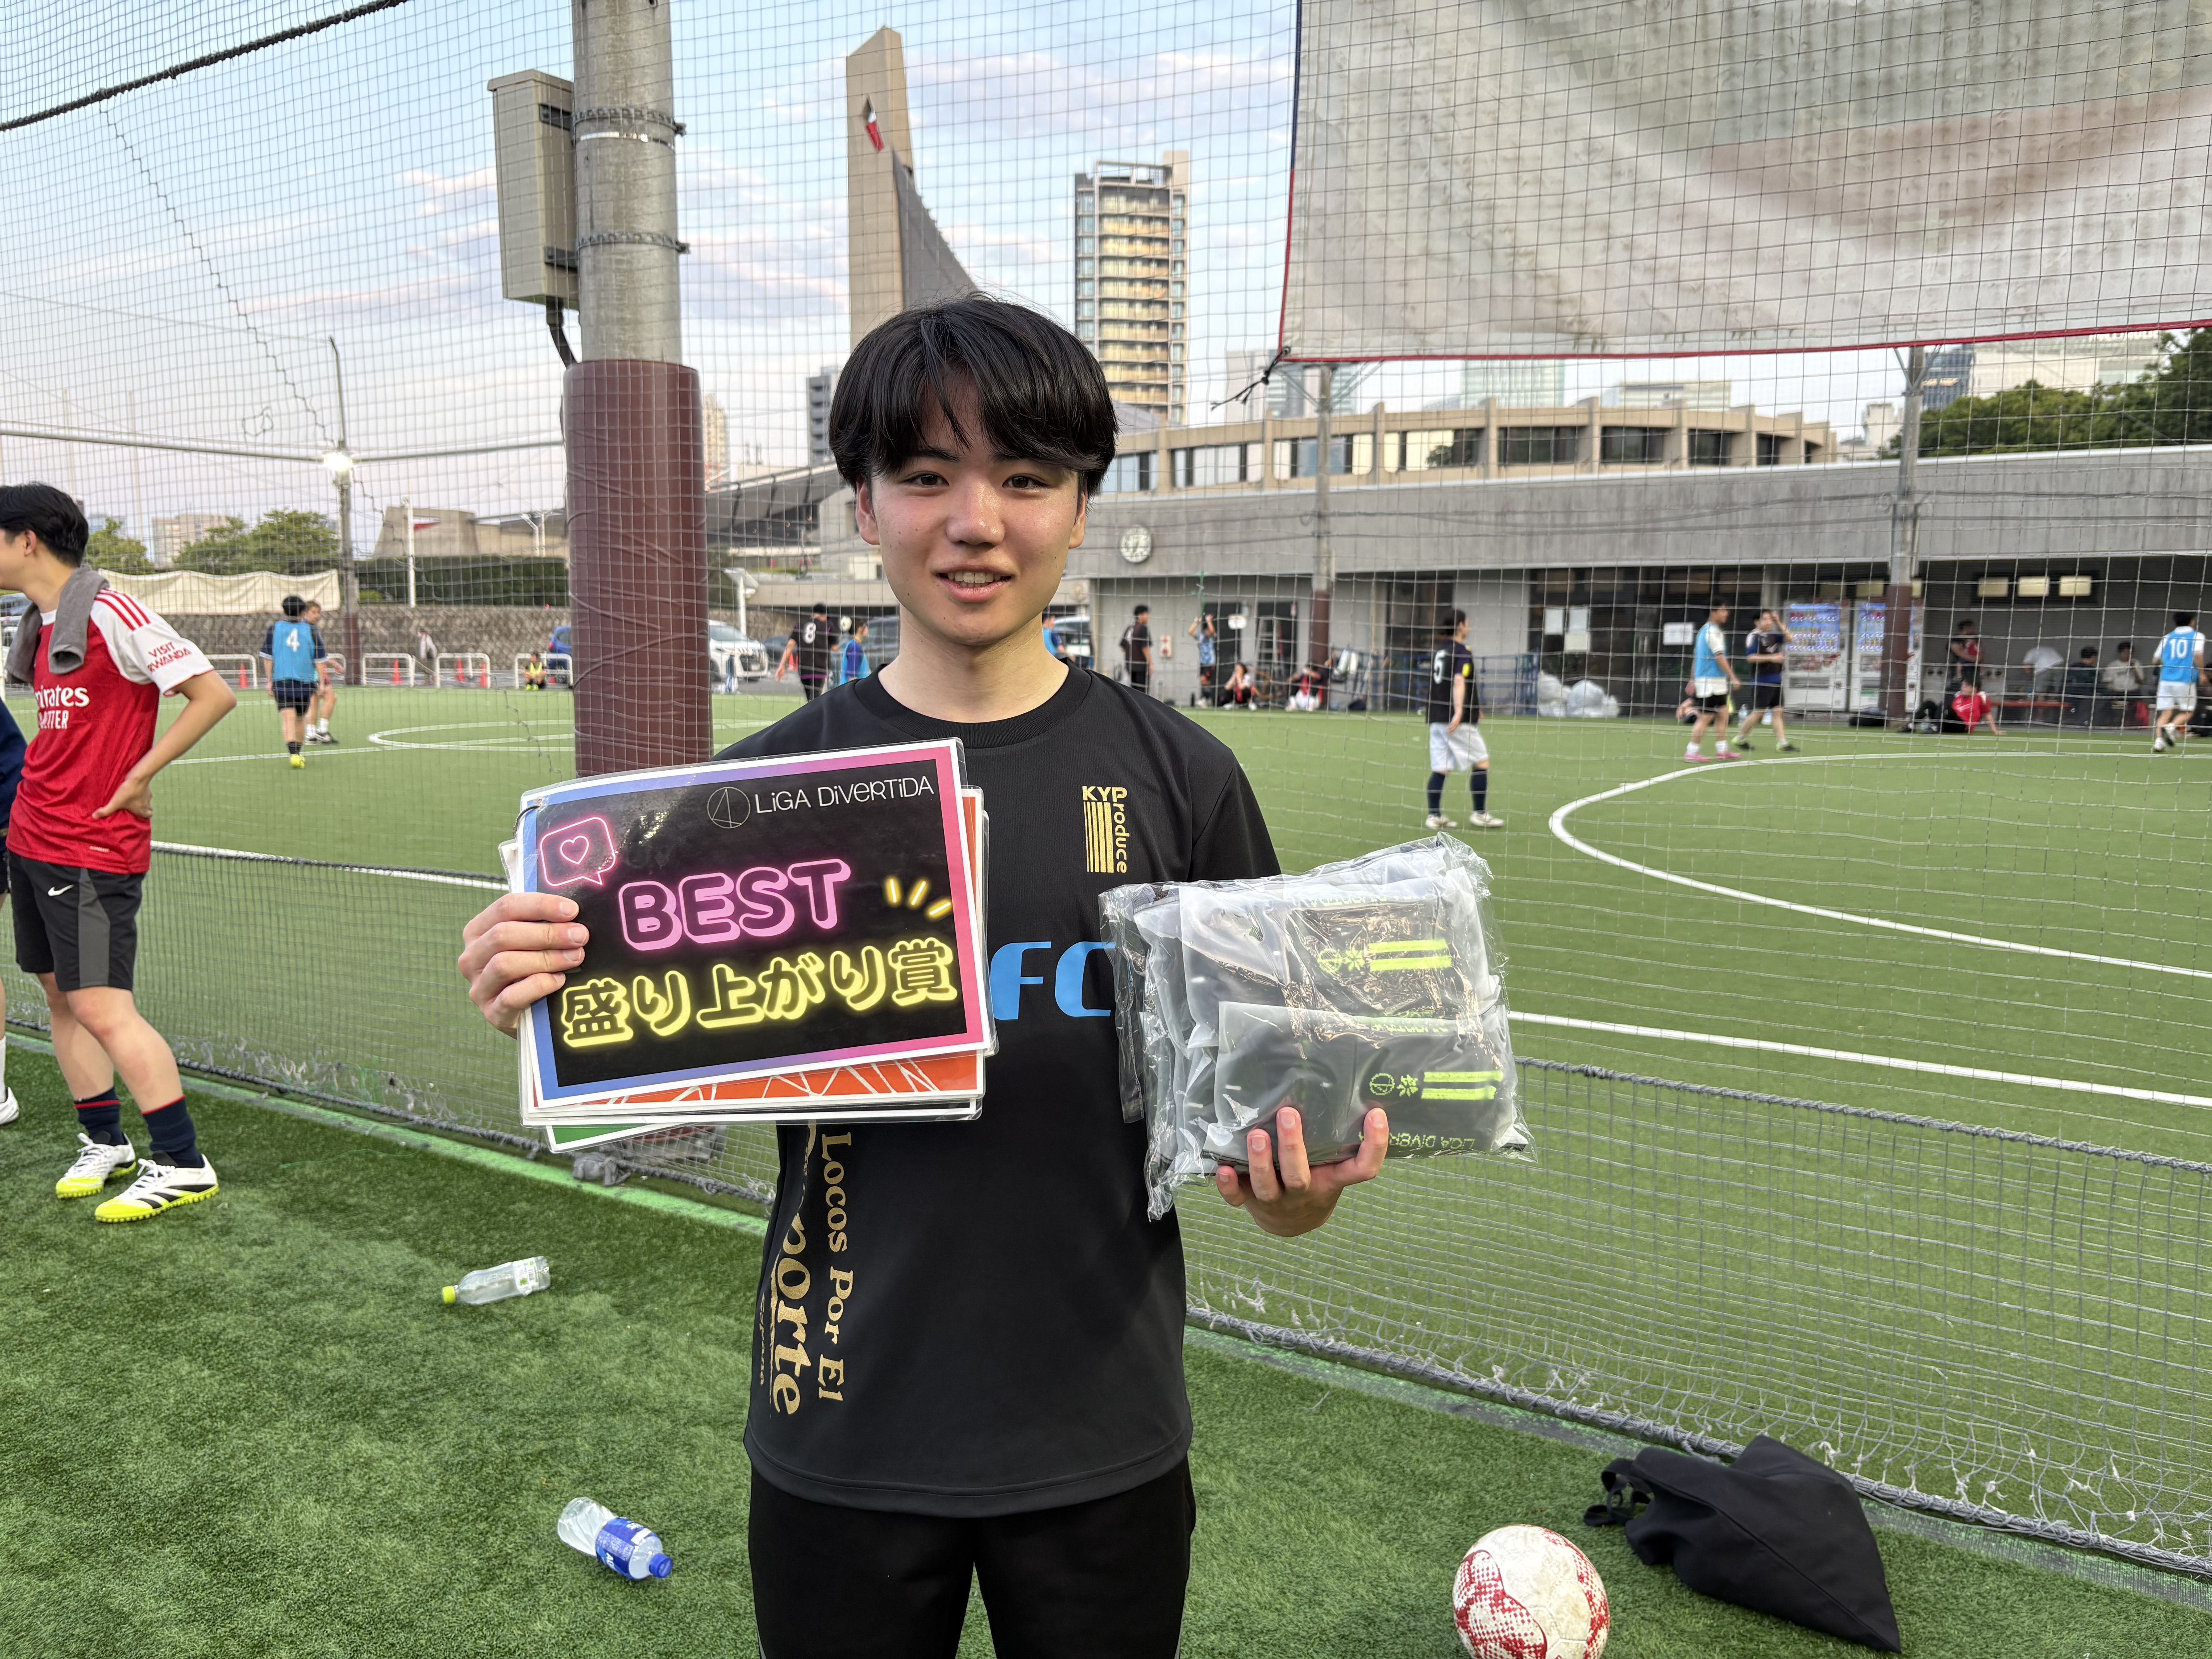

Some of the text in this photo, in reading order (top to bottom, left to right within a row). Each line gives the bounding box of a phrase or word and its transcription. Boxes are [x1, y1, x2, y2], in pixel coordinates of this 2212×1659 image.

[286, 628, 300, 652] 4
[804, 622, 816, 644] 8
[148, 641, 175, 658] VISIT
[148, 647, 192, 672] RWANDA
[2169, 638, 2188, 658] 10
[618, 859, 851, 951] BEST
[561, 936, 958, 1048] 盛り上がり賞
[817, 1132, 854, 1402] Locos Por El
